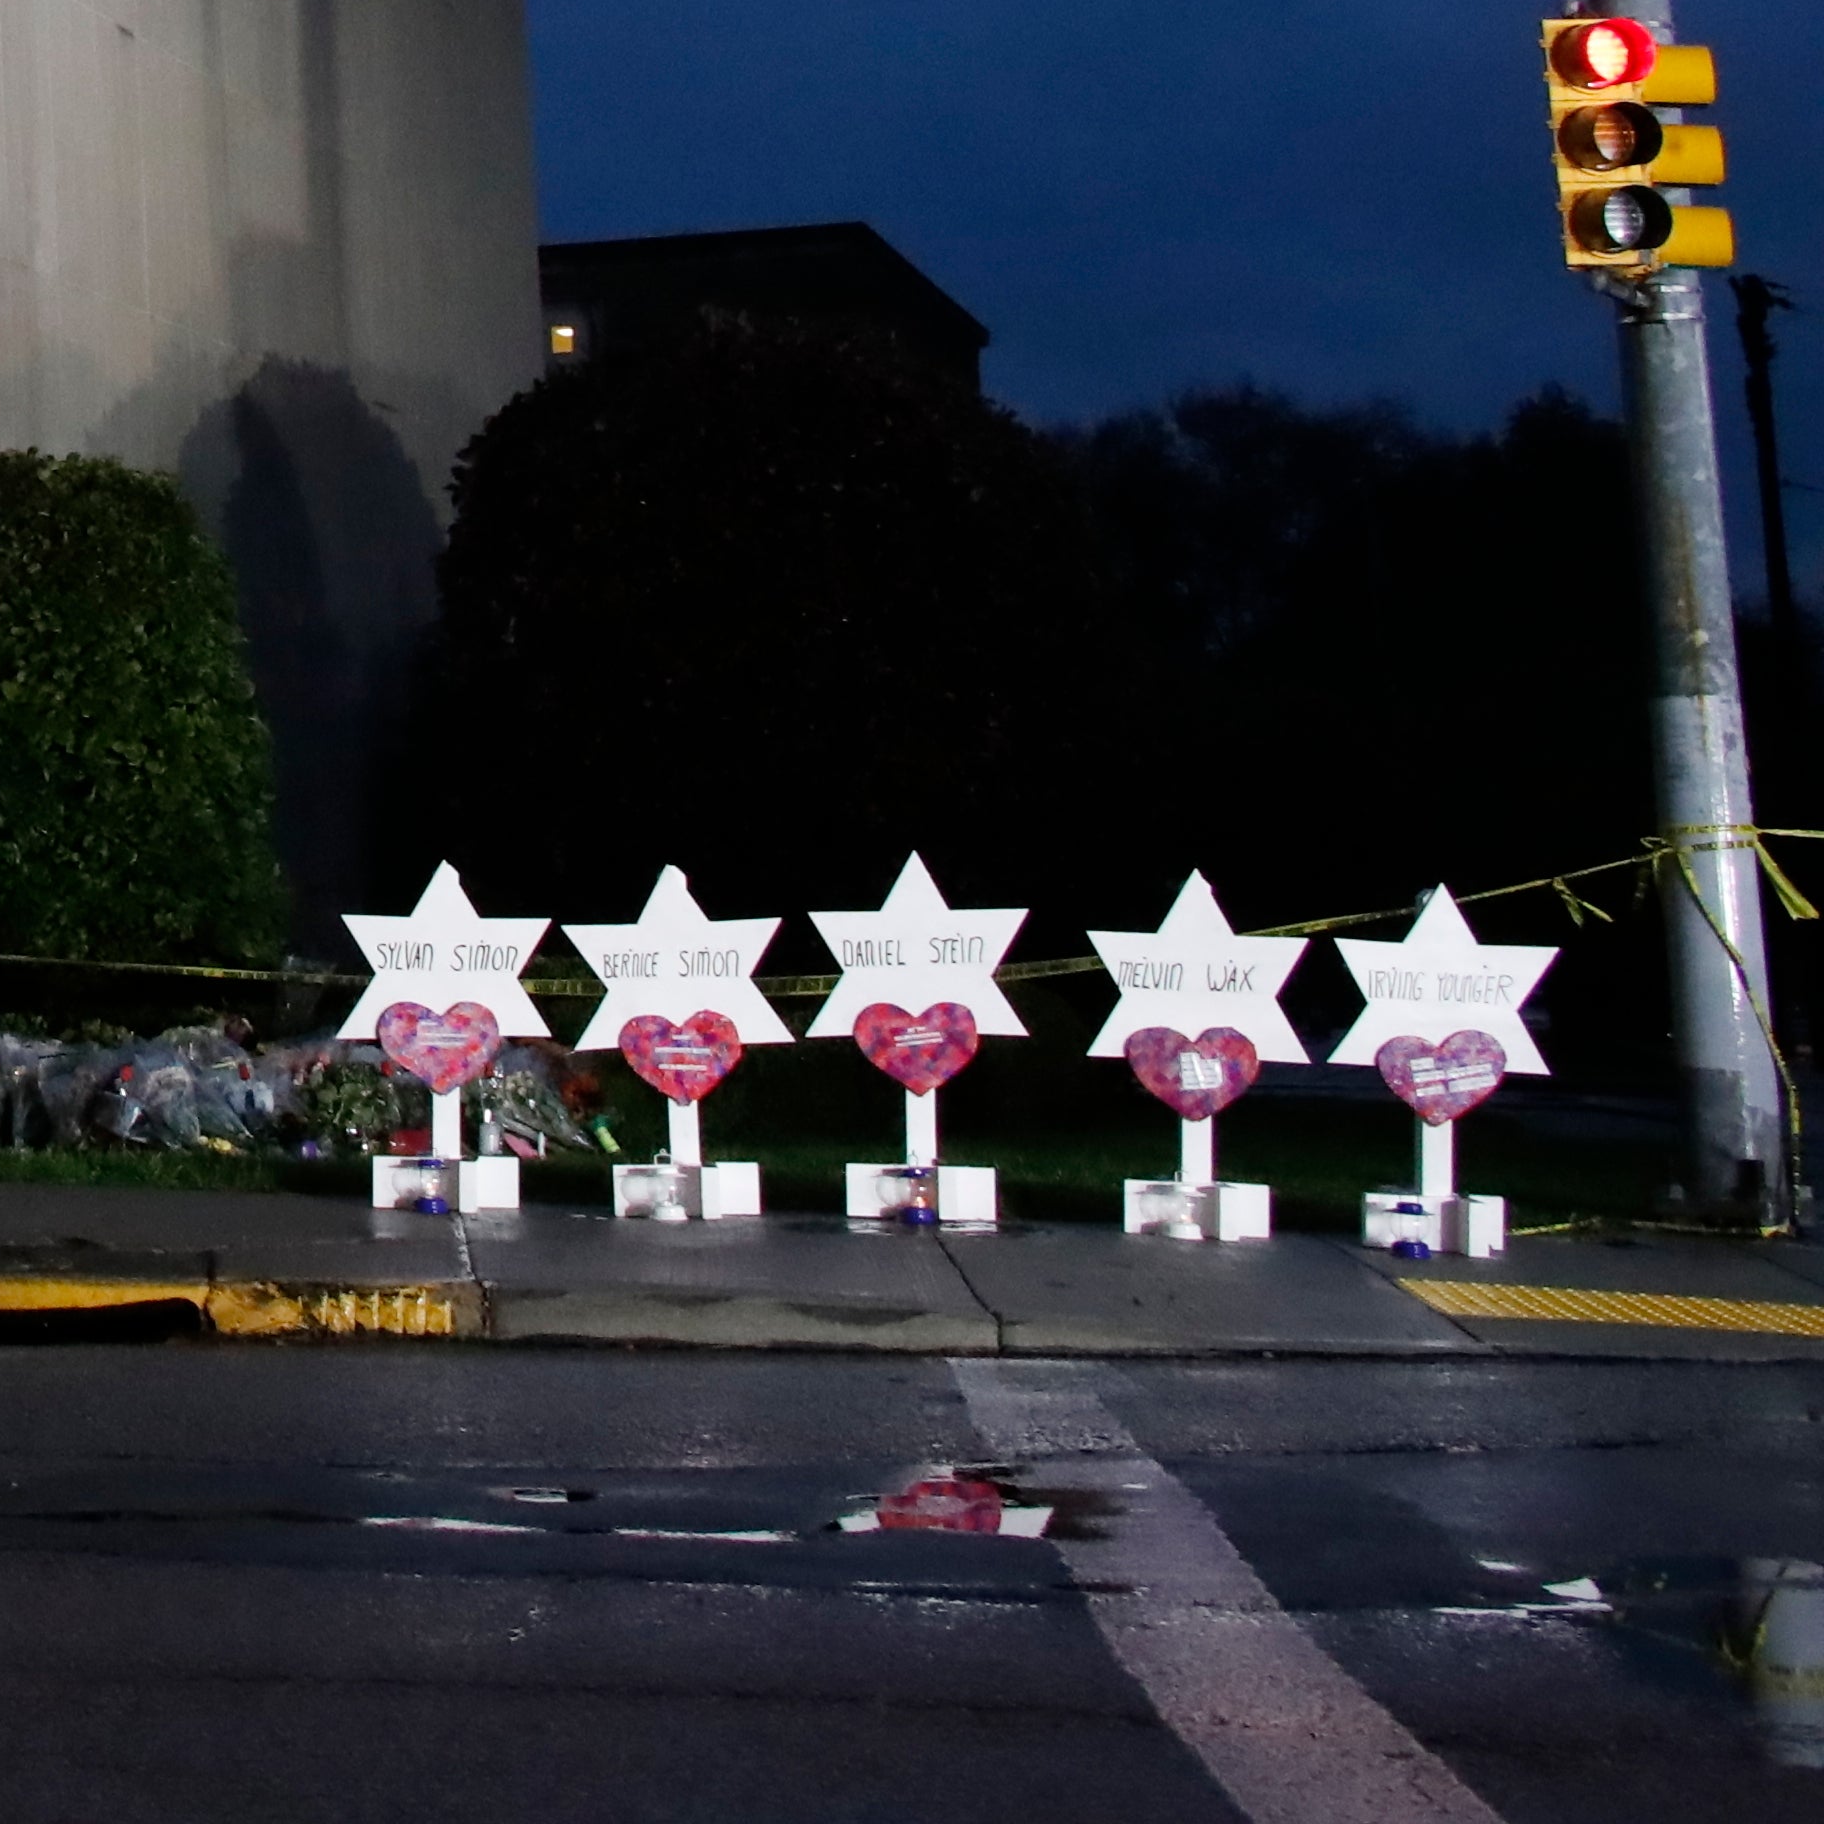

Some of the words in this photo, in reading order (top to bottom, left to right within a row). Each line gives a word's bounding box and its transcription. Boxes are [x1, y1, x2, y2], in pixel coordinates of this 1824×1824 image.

[376, 941, 434, 972] SYLVAN
[450, 941, 518, 972] SIMON
[603, 950, 660, 979] BERNICE
[678, 948, 740, 978] SIMON
[842, 938, 906, 967] DANIEL
[929, 934, 984, 964] STEIN
[1118, 959, 1184, 991] MELVIN
[1207, 961, 1256, 992] WAX
[1367, 969, 1424, 1002] IRVING
[1437, 972, 1515, 1004] YOUNGER
